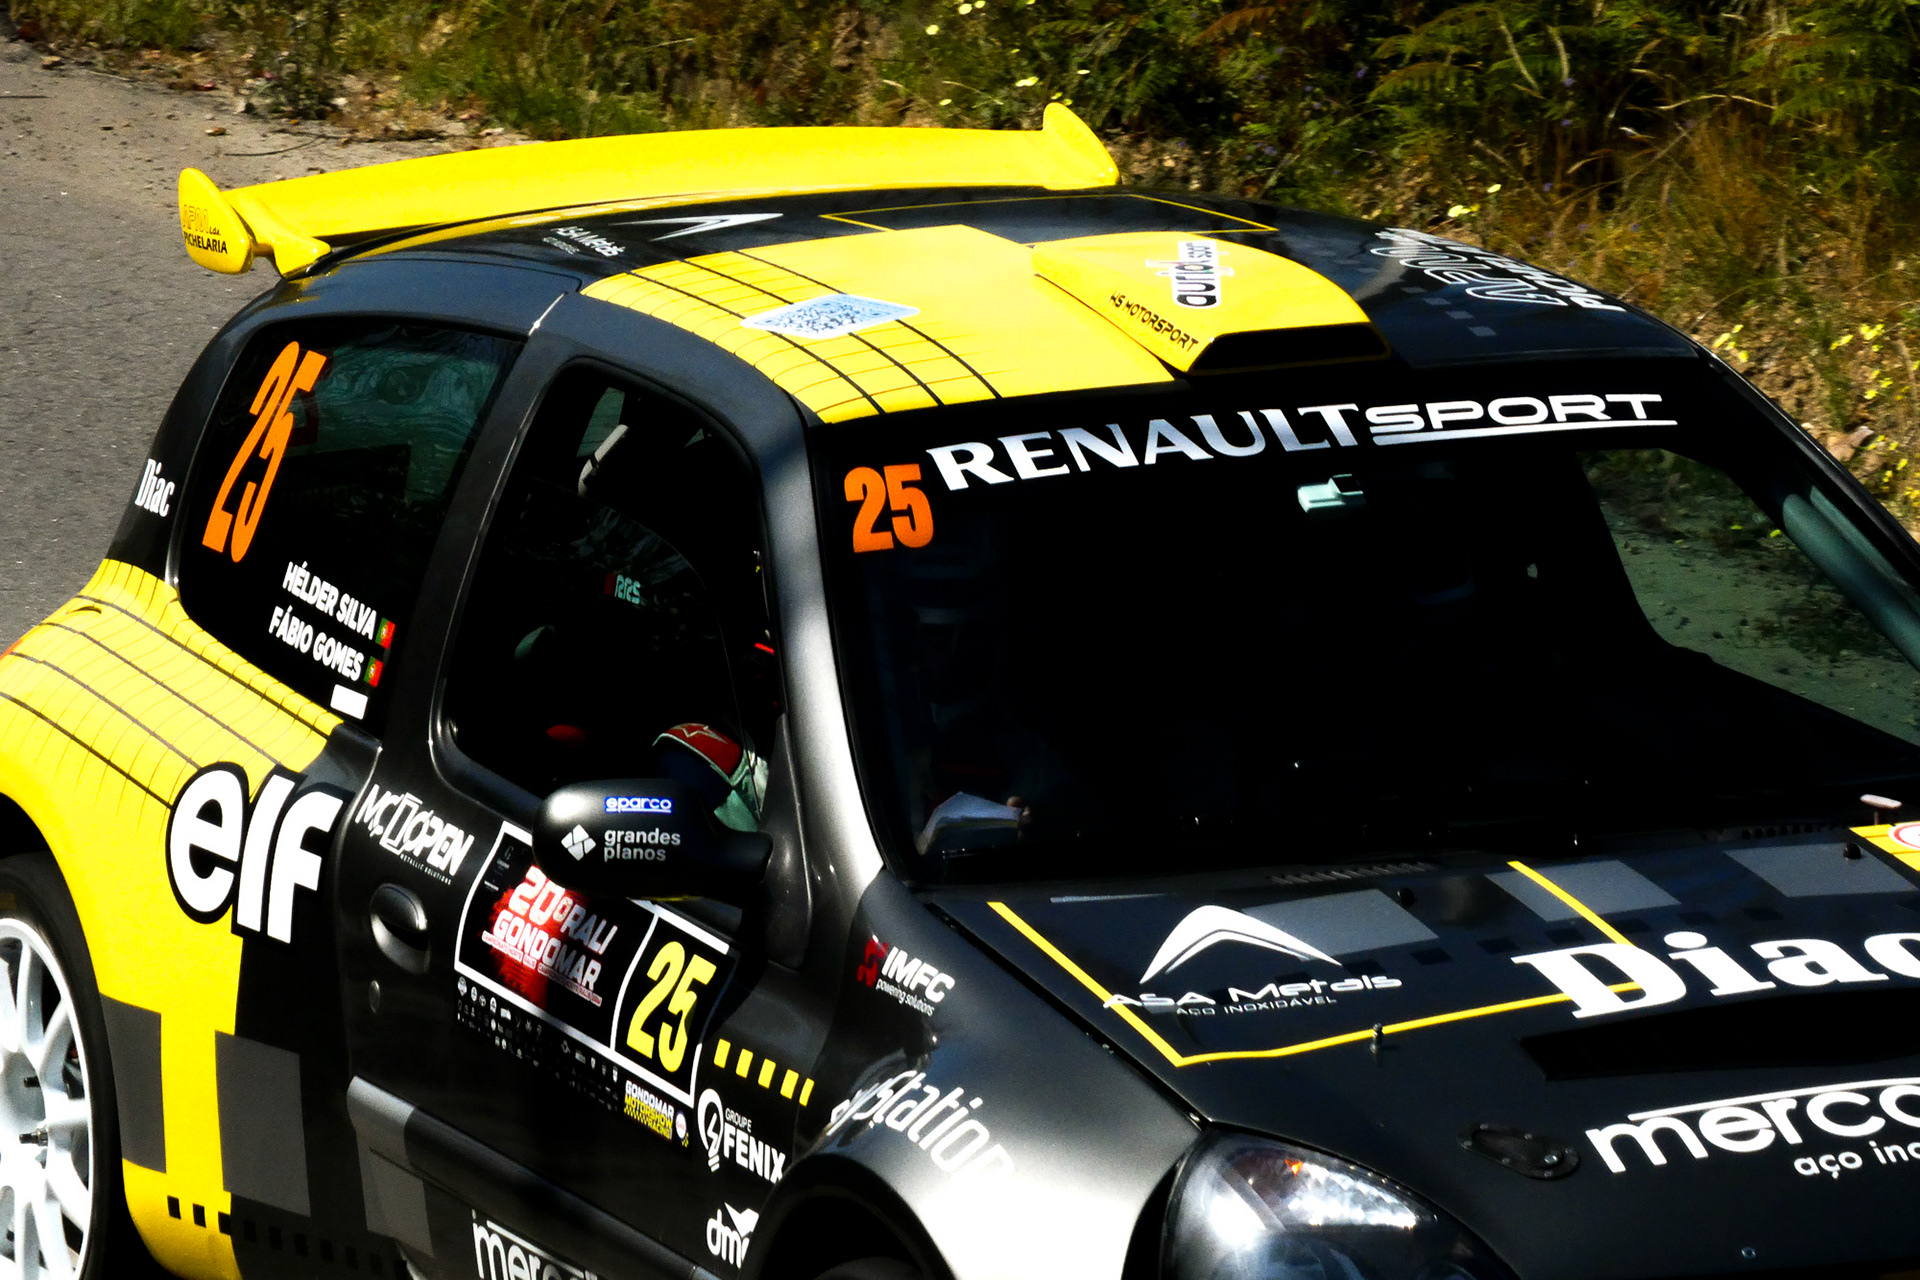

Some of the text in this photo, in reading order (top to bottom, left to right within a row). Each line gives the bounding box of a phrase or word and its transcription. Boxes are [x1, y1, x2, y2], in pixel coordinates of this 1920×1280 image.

[1122, 300, 1199, 352] MOTORSPORT
[202, 341, 327, 563] 25
[134, 458, 176, 517] Diac
[844, 464, 934, 553] 25
[282, 561, 377, 640] HÉLDER SILVA
[268, 605, 365, 682] FÁBIO GOMES
[167, 768, 345, 945] elf
[603, 843, 667, 863] planos
[604, 828, 681, 847] grandes
[492, 908, 602, 992] GONDOMAR
[560, 904, 619, 955] RALI
[881, 946, 956, 1004] IMFC
[1103, 974, 1403, 1009] ASA Metals
[626, 942, 717, 1072] 25
[624, 1093, 673, 1129] MOTORSHOW
[625, 1080, 675, 1120] GONDOMAR
[724, 1107, 753, 1133] GROUPE
[723, 1122, 786, 1184] FENIX
[1793, 1151, 1863, 1179] aço
